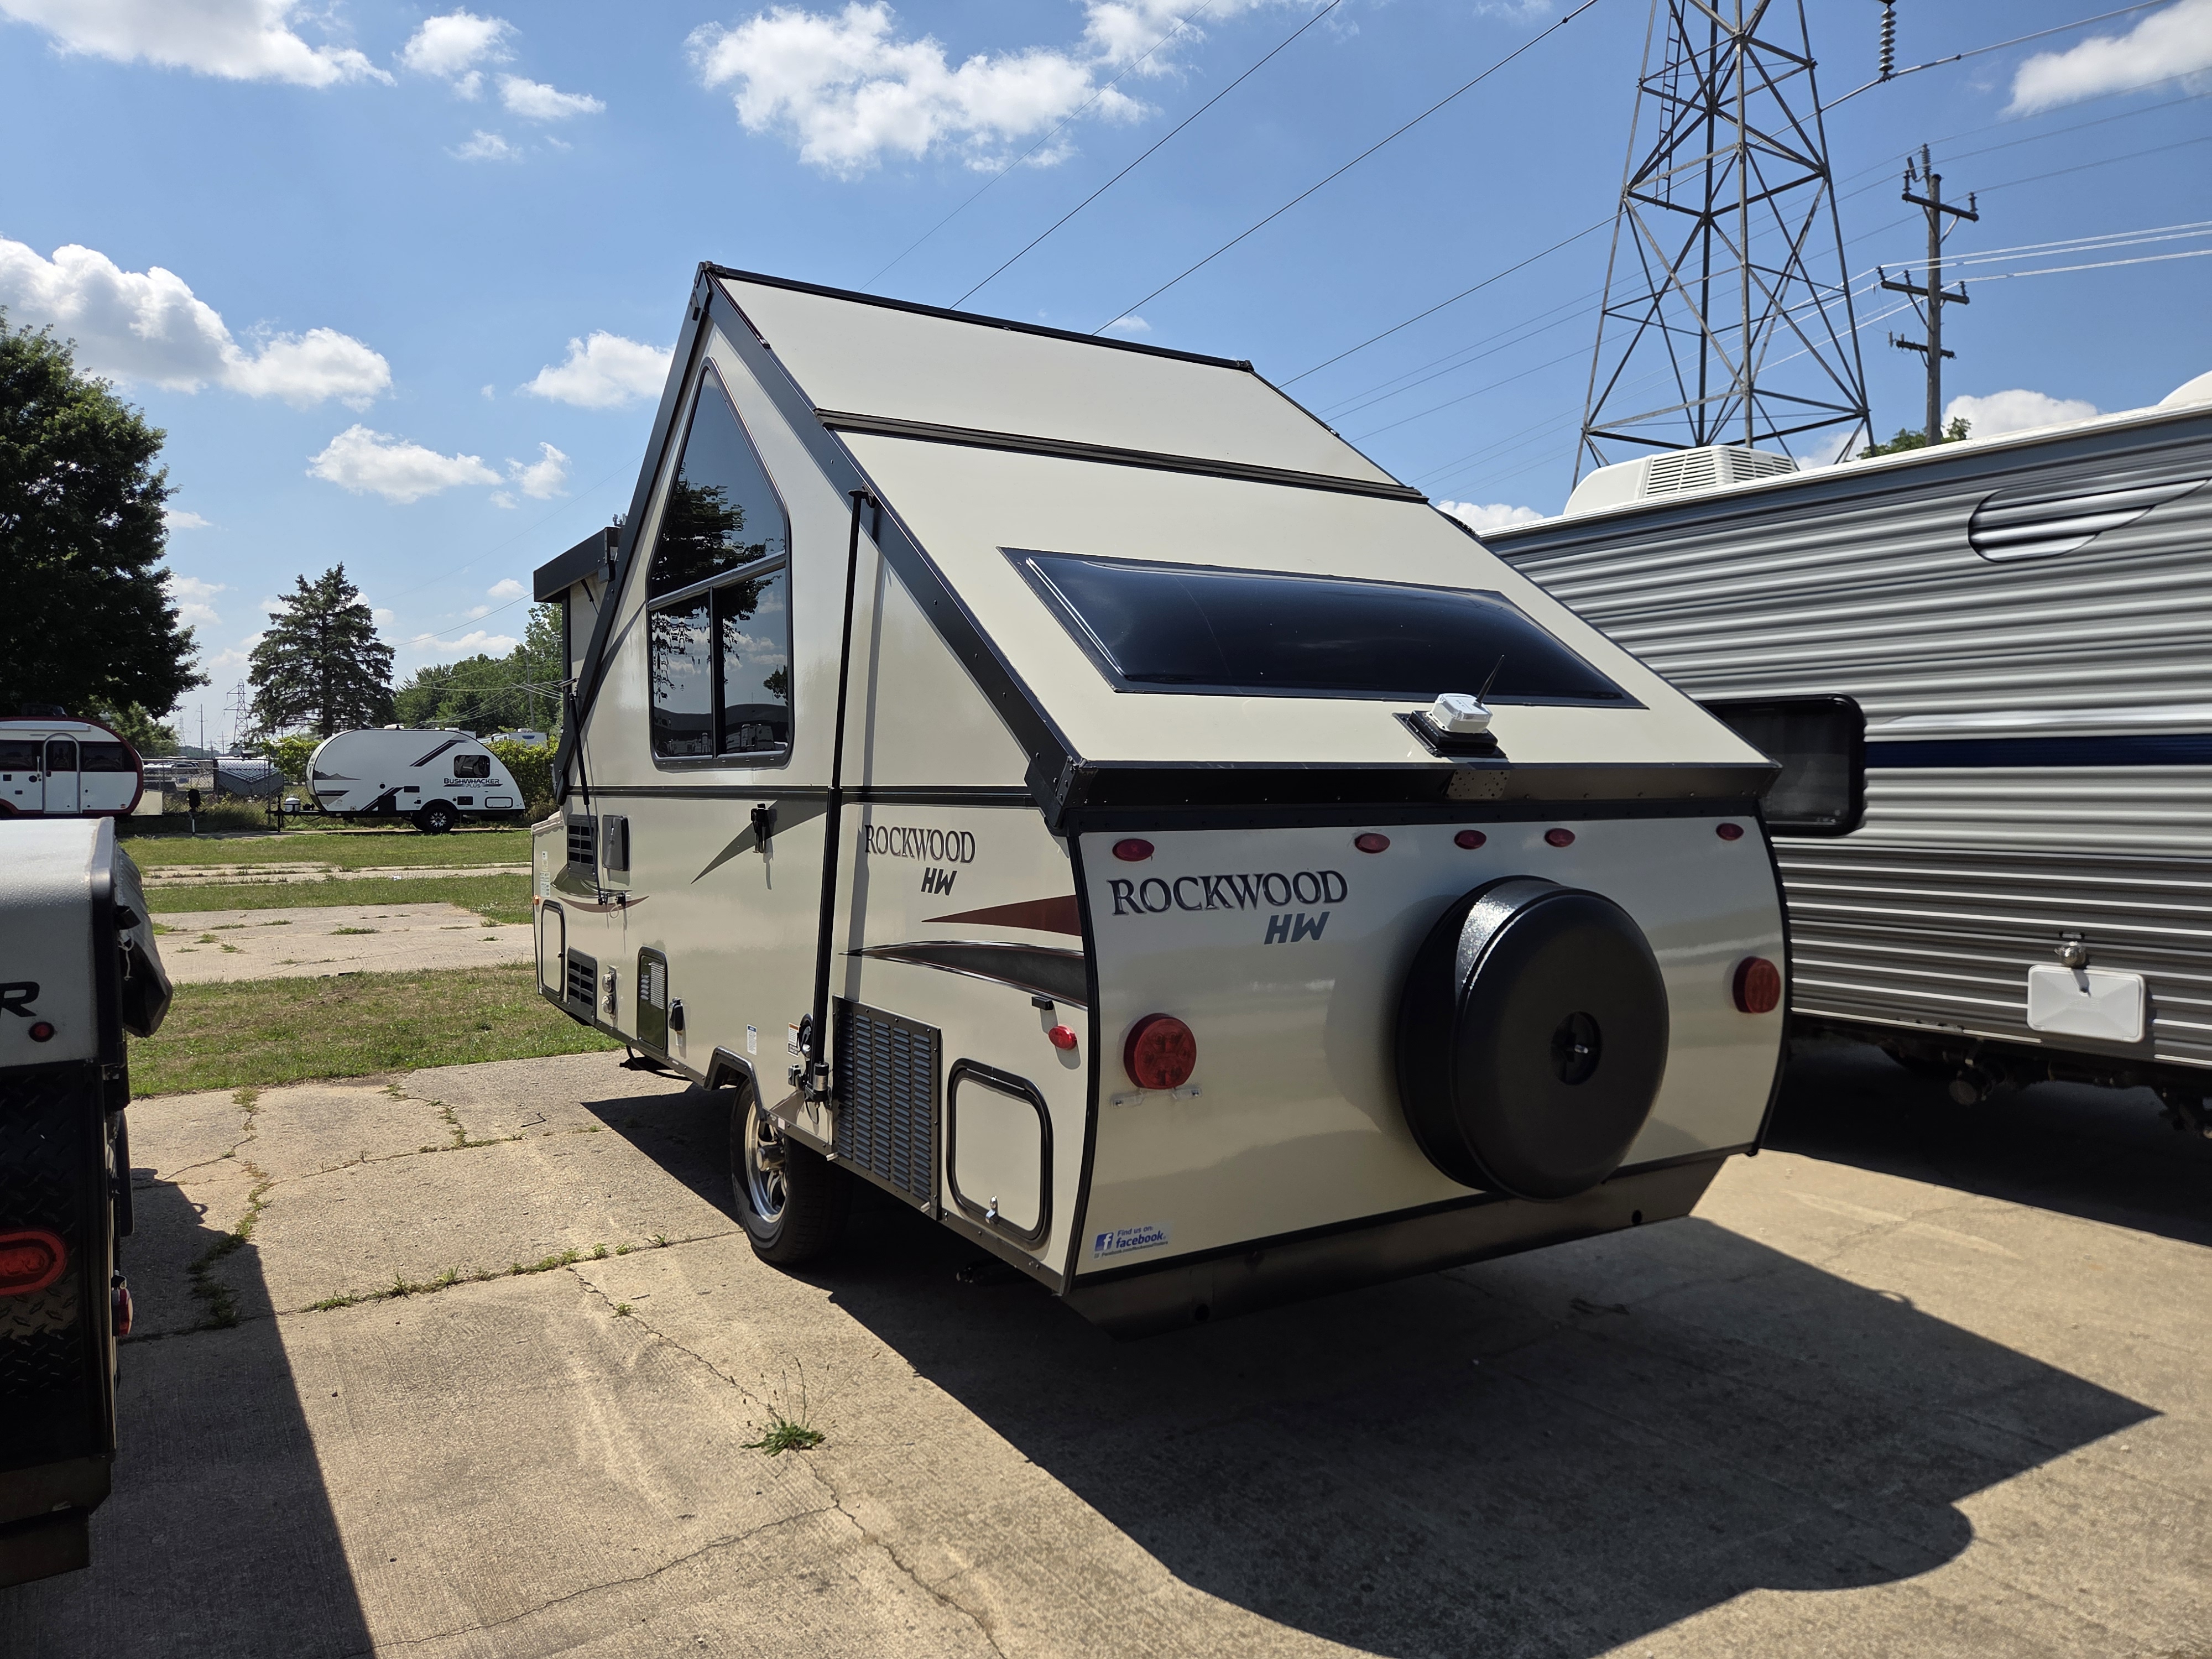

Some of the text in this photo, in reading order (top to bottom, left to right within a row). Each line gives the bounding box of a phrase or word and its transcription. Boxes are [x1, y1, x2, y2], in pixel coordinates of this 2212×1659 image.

[864, 824, 976, 864] ROCKWOOD
[921, 867, 957, 896] HW
[1107, 870, 1348, 916] ROCKWOOD
[1264, 911, 1331, 946] HW
[1117, 1228, 1132, 1237] Find
